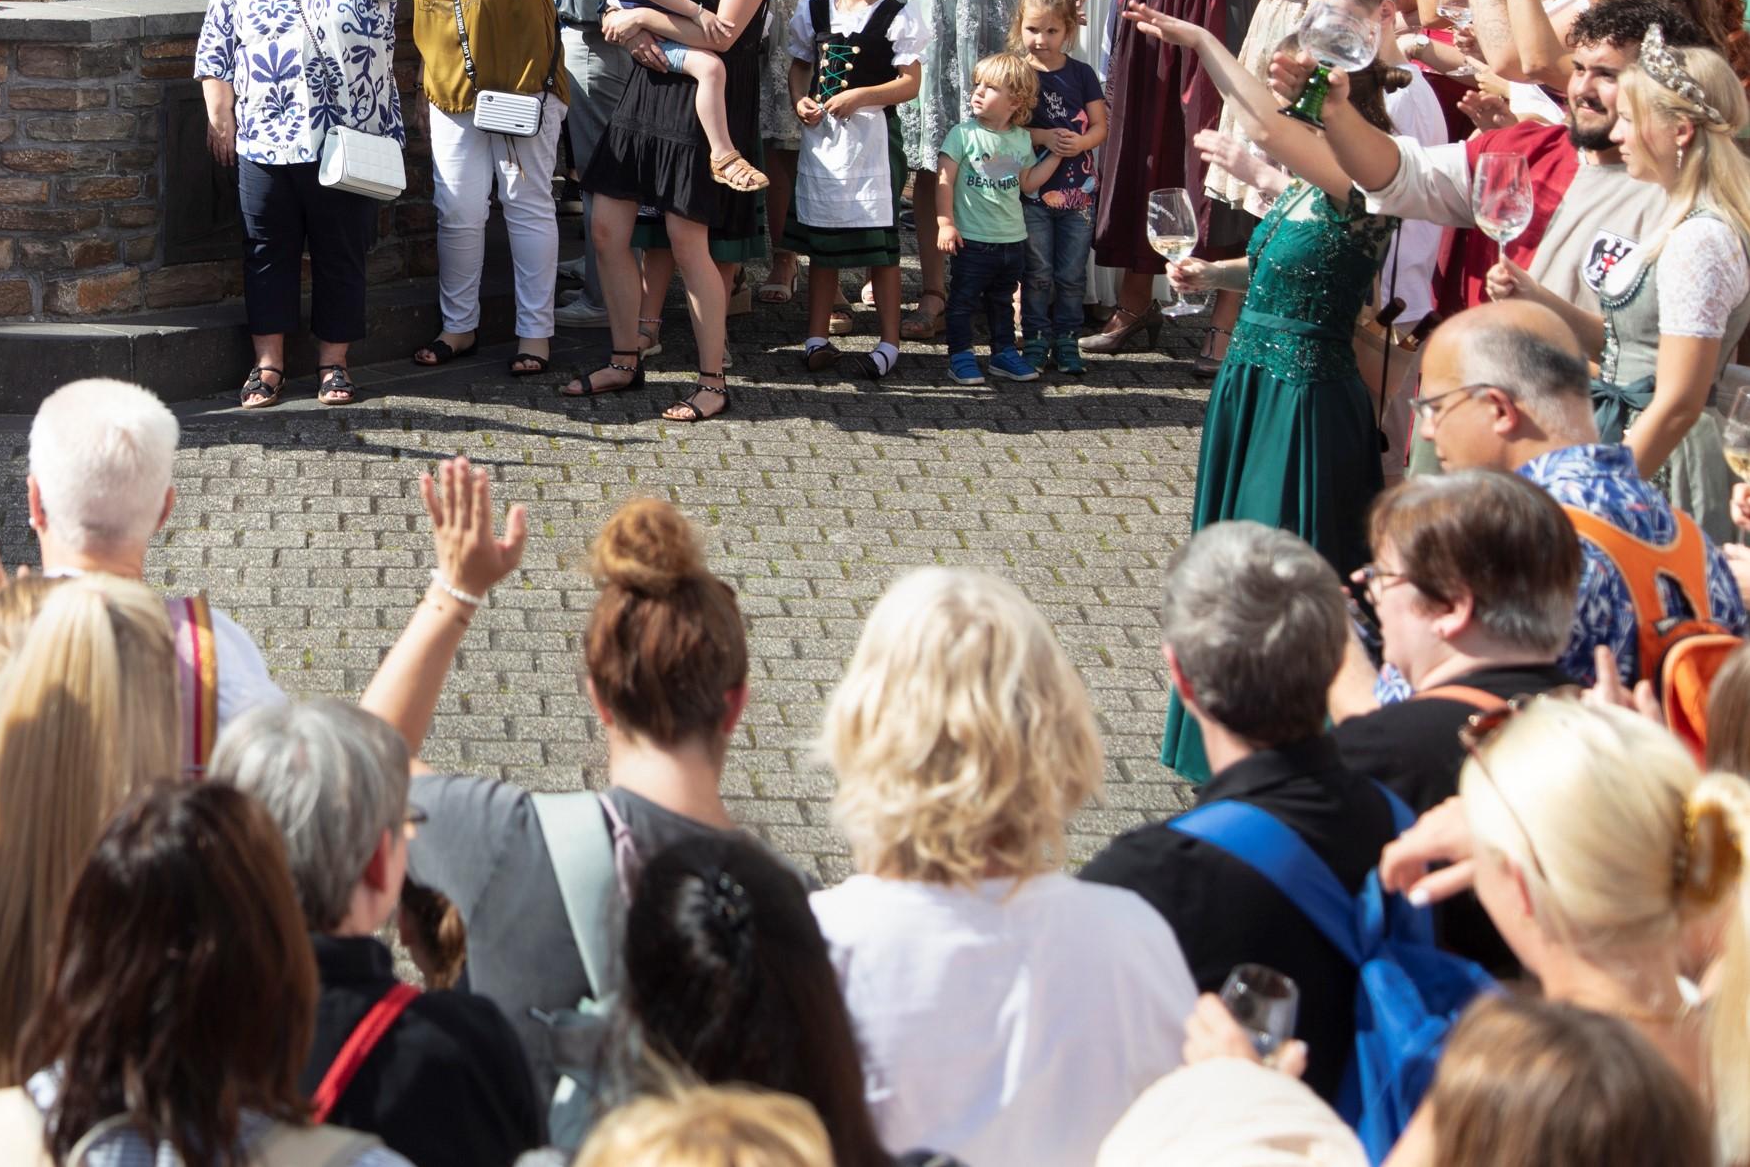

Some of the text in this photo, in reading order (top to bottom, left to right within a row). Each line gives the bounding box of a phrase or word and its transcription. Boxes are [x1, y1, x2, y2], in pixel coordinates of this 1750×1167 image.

[453, 5, 465, 34] FOREVER
[461, 41, 471, 59] LOVE
[966, 175, 997, 190] BEAR
